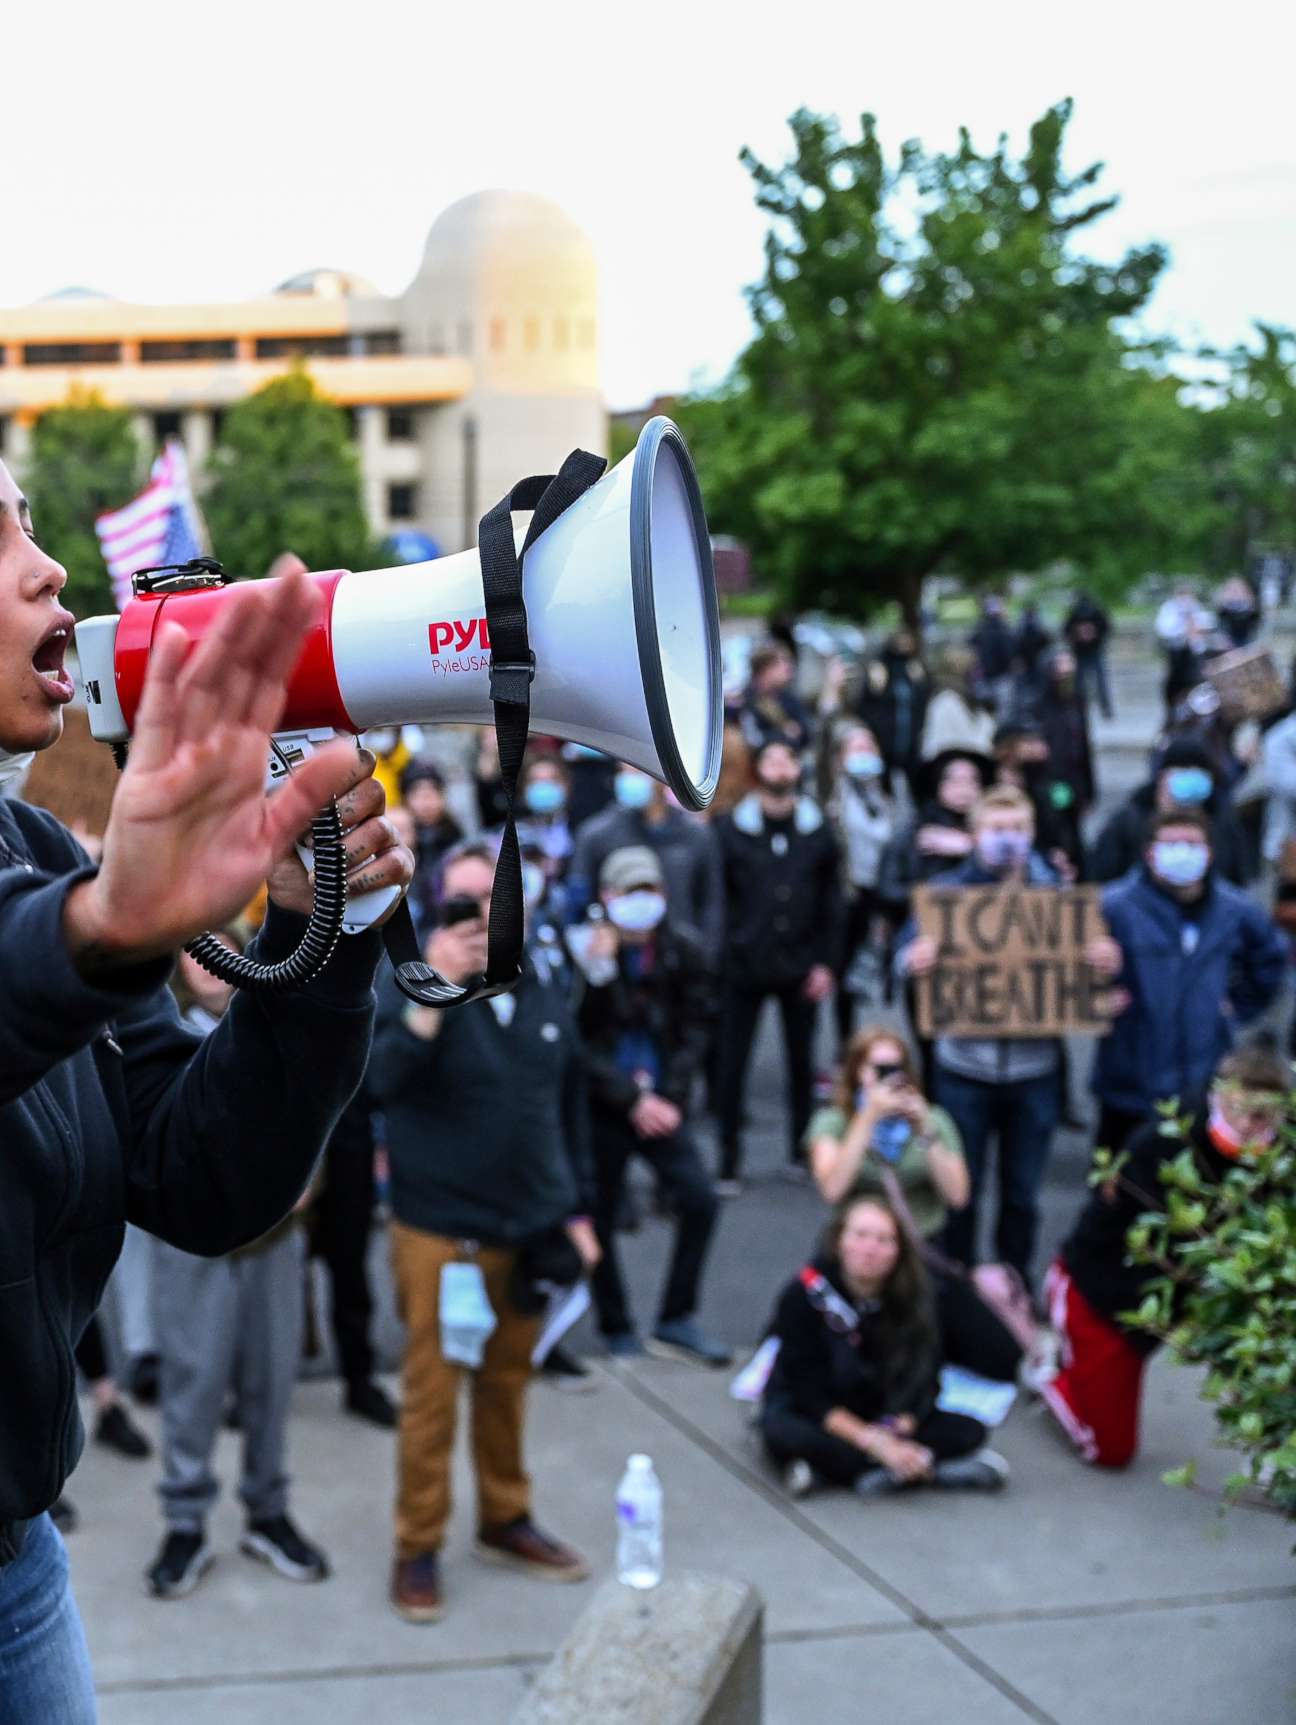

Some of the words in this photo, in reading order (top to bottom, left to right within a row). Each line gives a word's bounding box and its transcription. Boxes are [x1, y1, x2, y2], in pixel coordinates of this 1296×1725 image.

[429, 618, 491, 655] PYL
[931, 891, 965, 956] I
[932, 958, 1108, 1026] BREATHE
